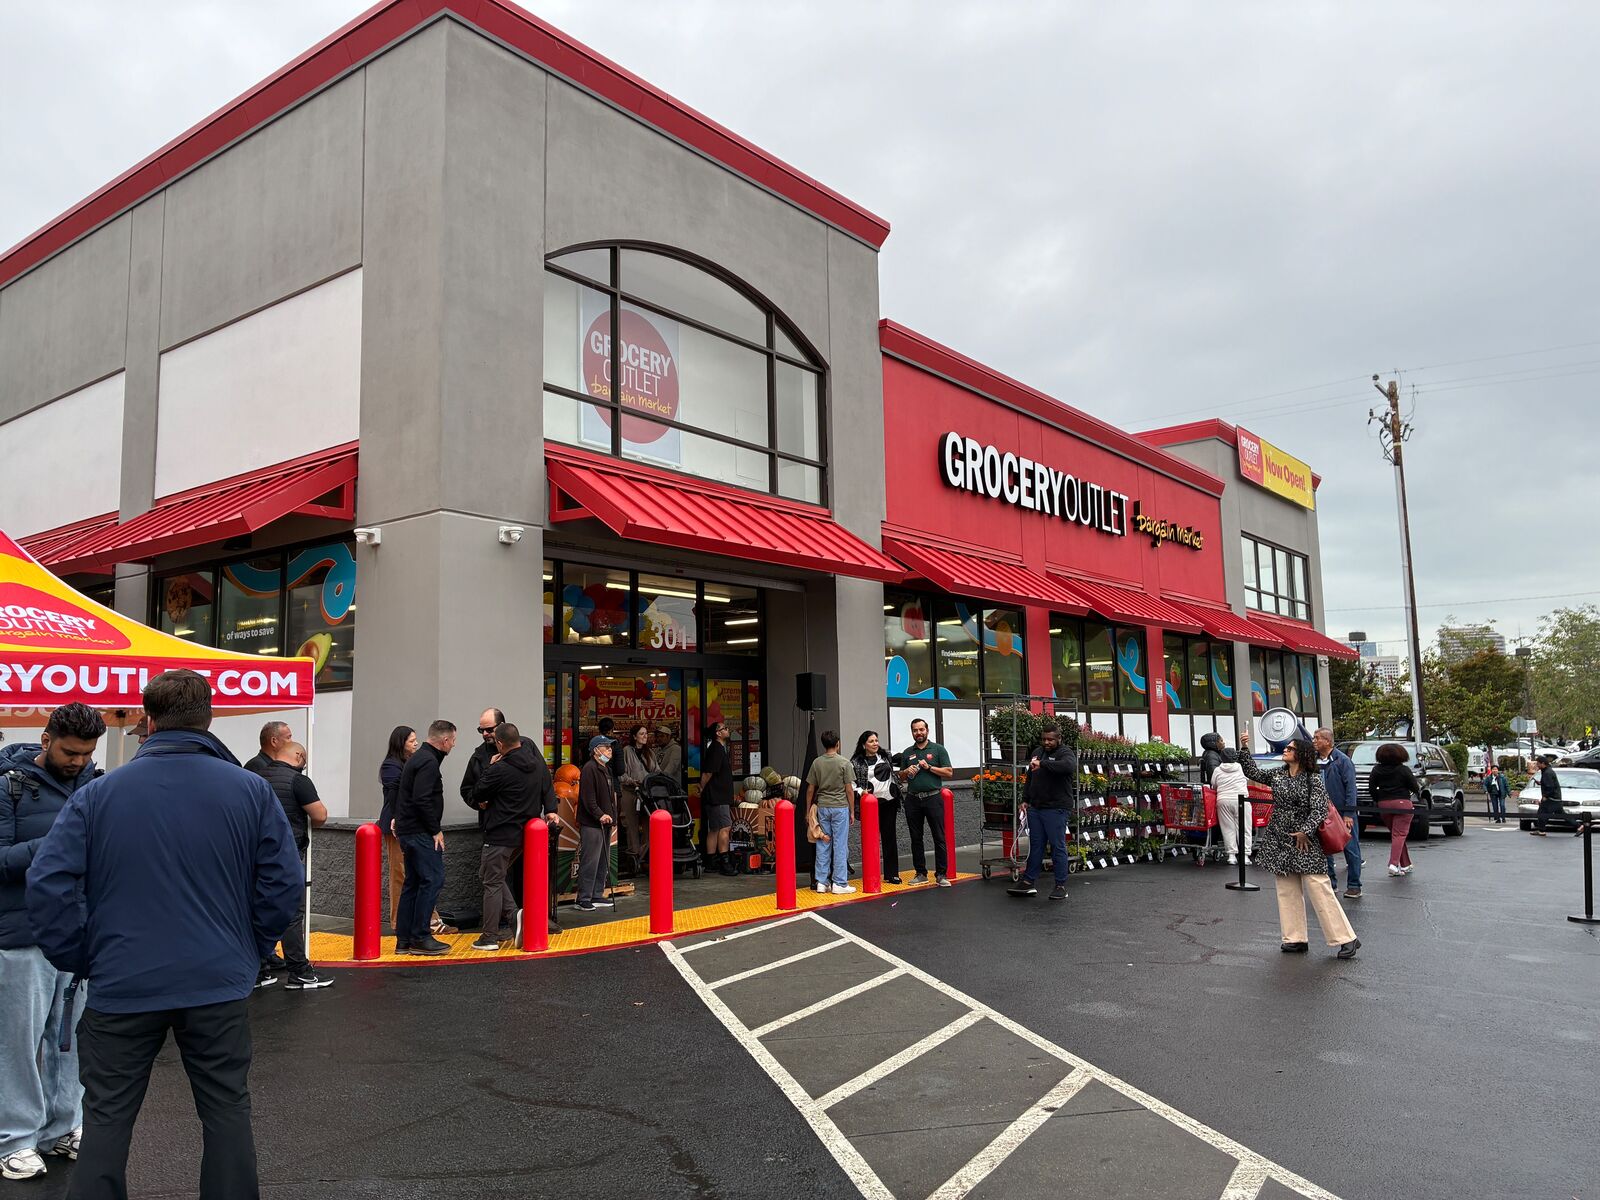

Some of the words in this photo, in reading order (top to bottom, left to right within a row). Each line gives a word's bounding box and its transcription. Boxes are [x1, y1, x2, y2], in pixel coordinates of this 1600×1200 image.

[638, 393, 672, 415] market
[1264, 454, 1283, 481] Now
[1283, 464, 1306, 492] Open!
[1136, 500, 1175, 548] bargain
[1176, 523, 1204, 549] market
[226, 631, 234, 640] of
[234, 630, 251, 639] ways
[251, 629, 259, 637] to
[259, 627, 274, 636] save
[650, 622, 687, 650] 301
[609, 695, 635, 710] 70%
